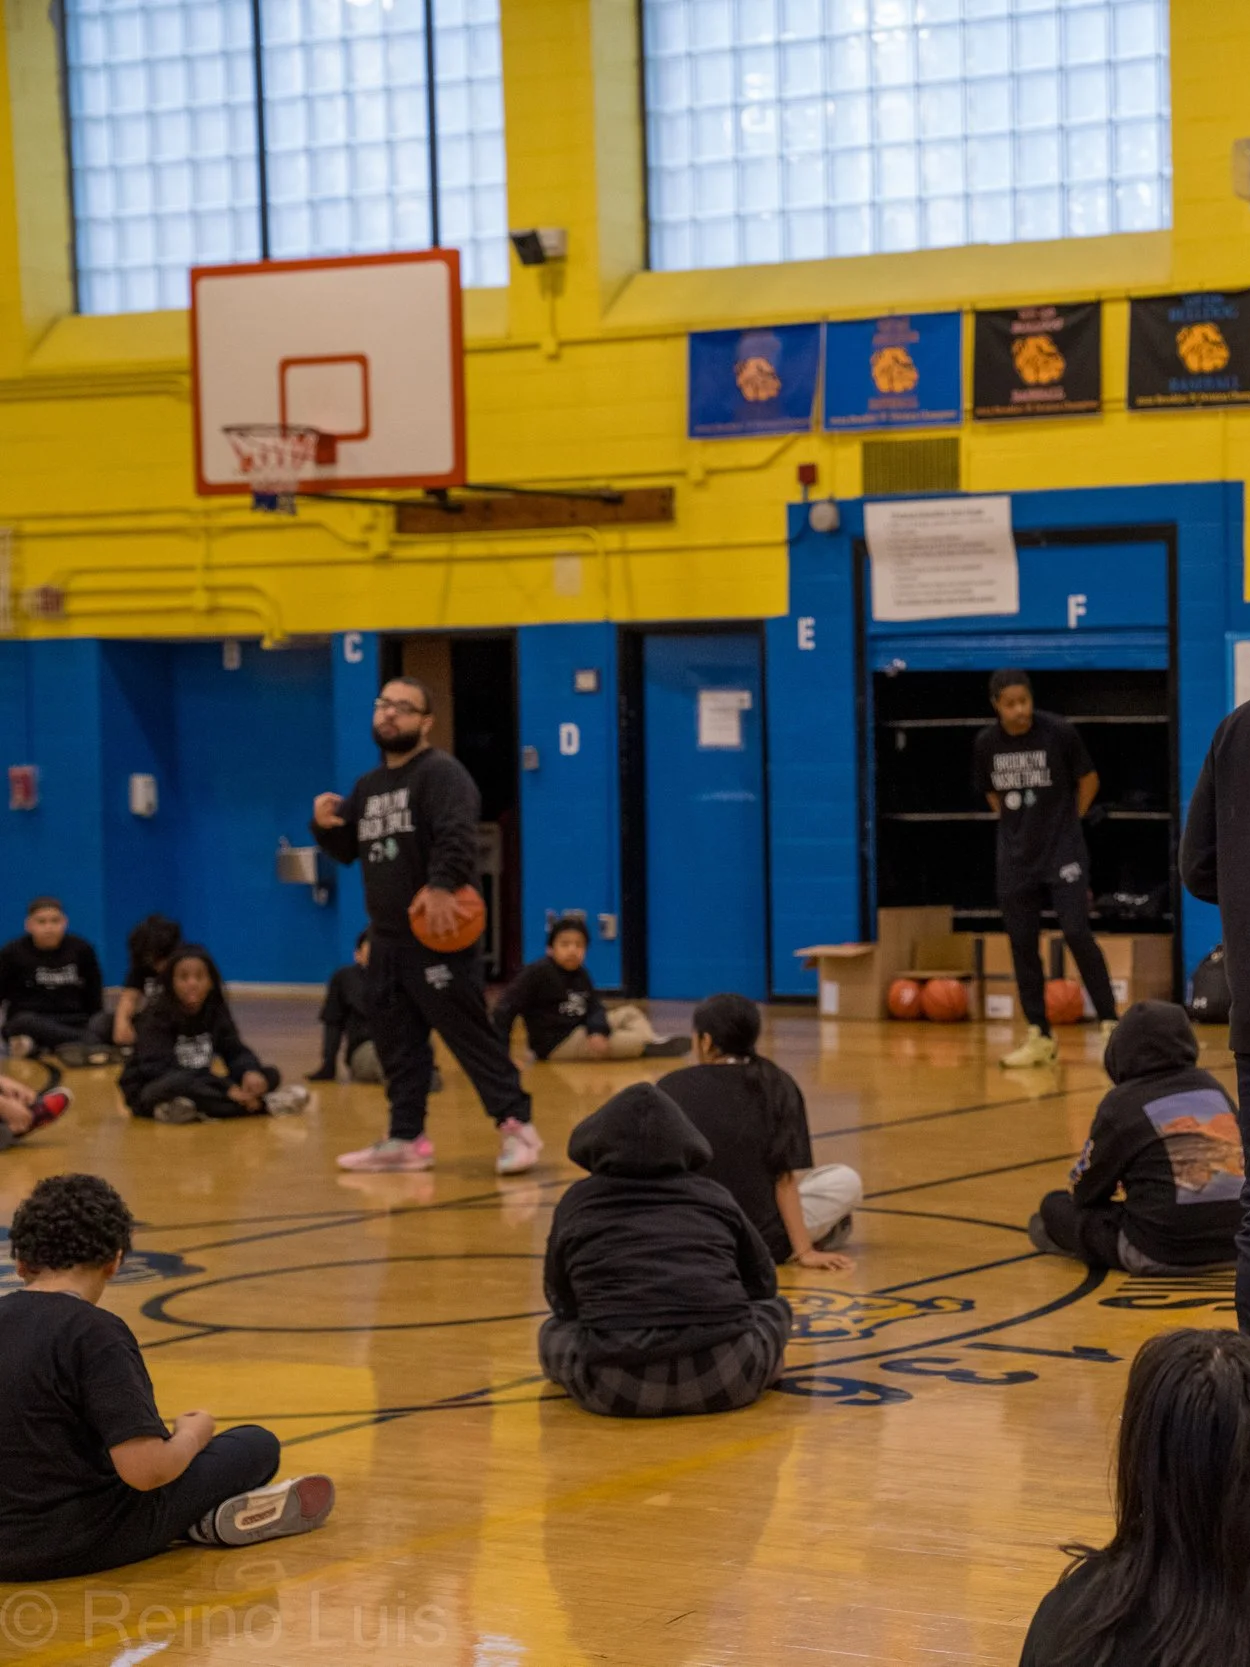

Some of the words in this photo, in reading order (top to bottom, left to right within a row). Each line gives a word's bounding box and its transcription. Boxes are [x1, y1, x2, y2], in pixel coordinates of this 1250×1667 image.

[1067, 594, 1087, 629] F
[343, 631, 363, 664] C
[797, 617, 815, 650] E
[559, 723, 580, 756] D
